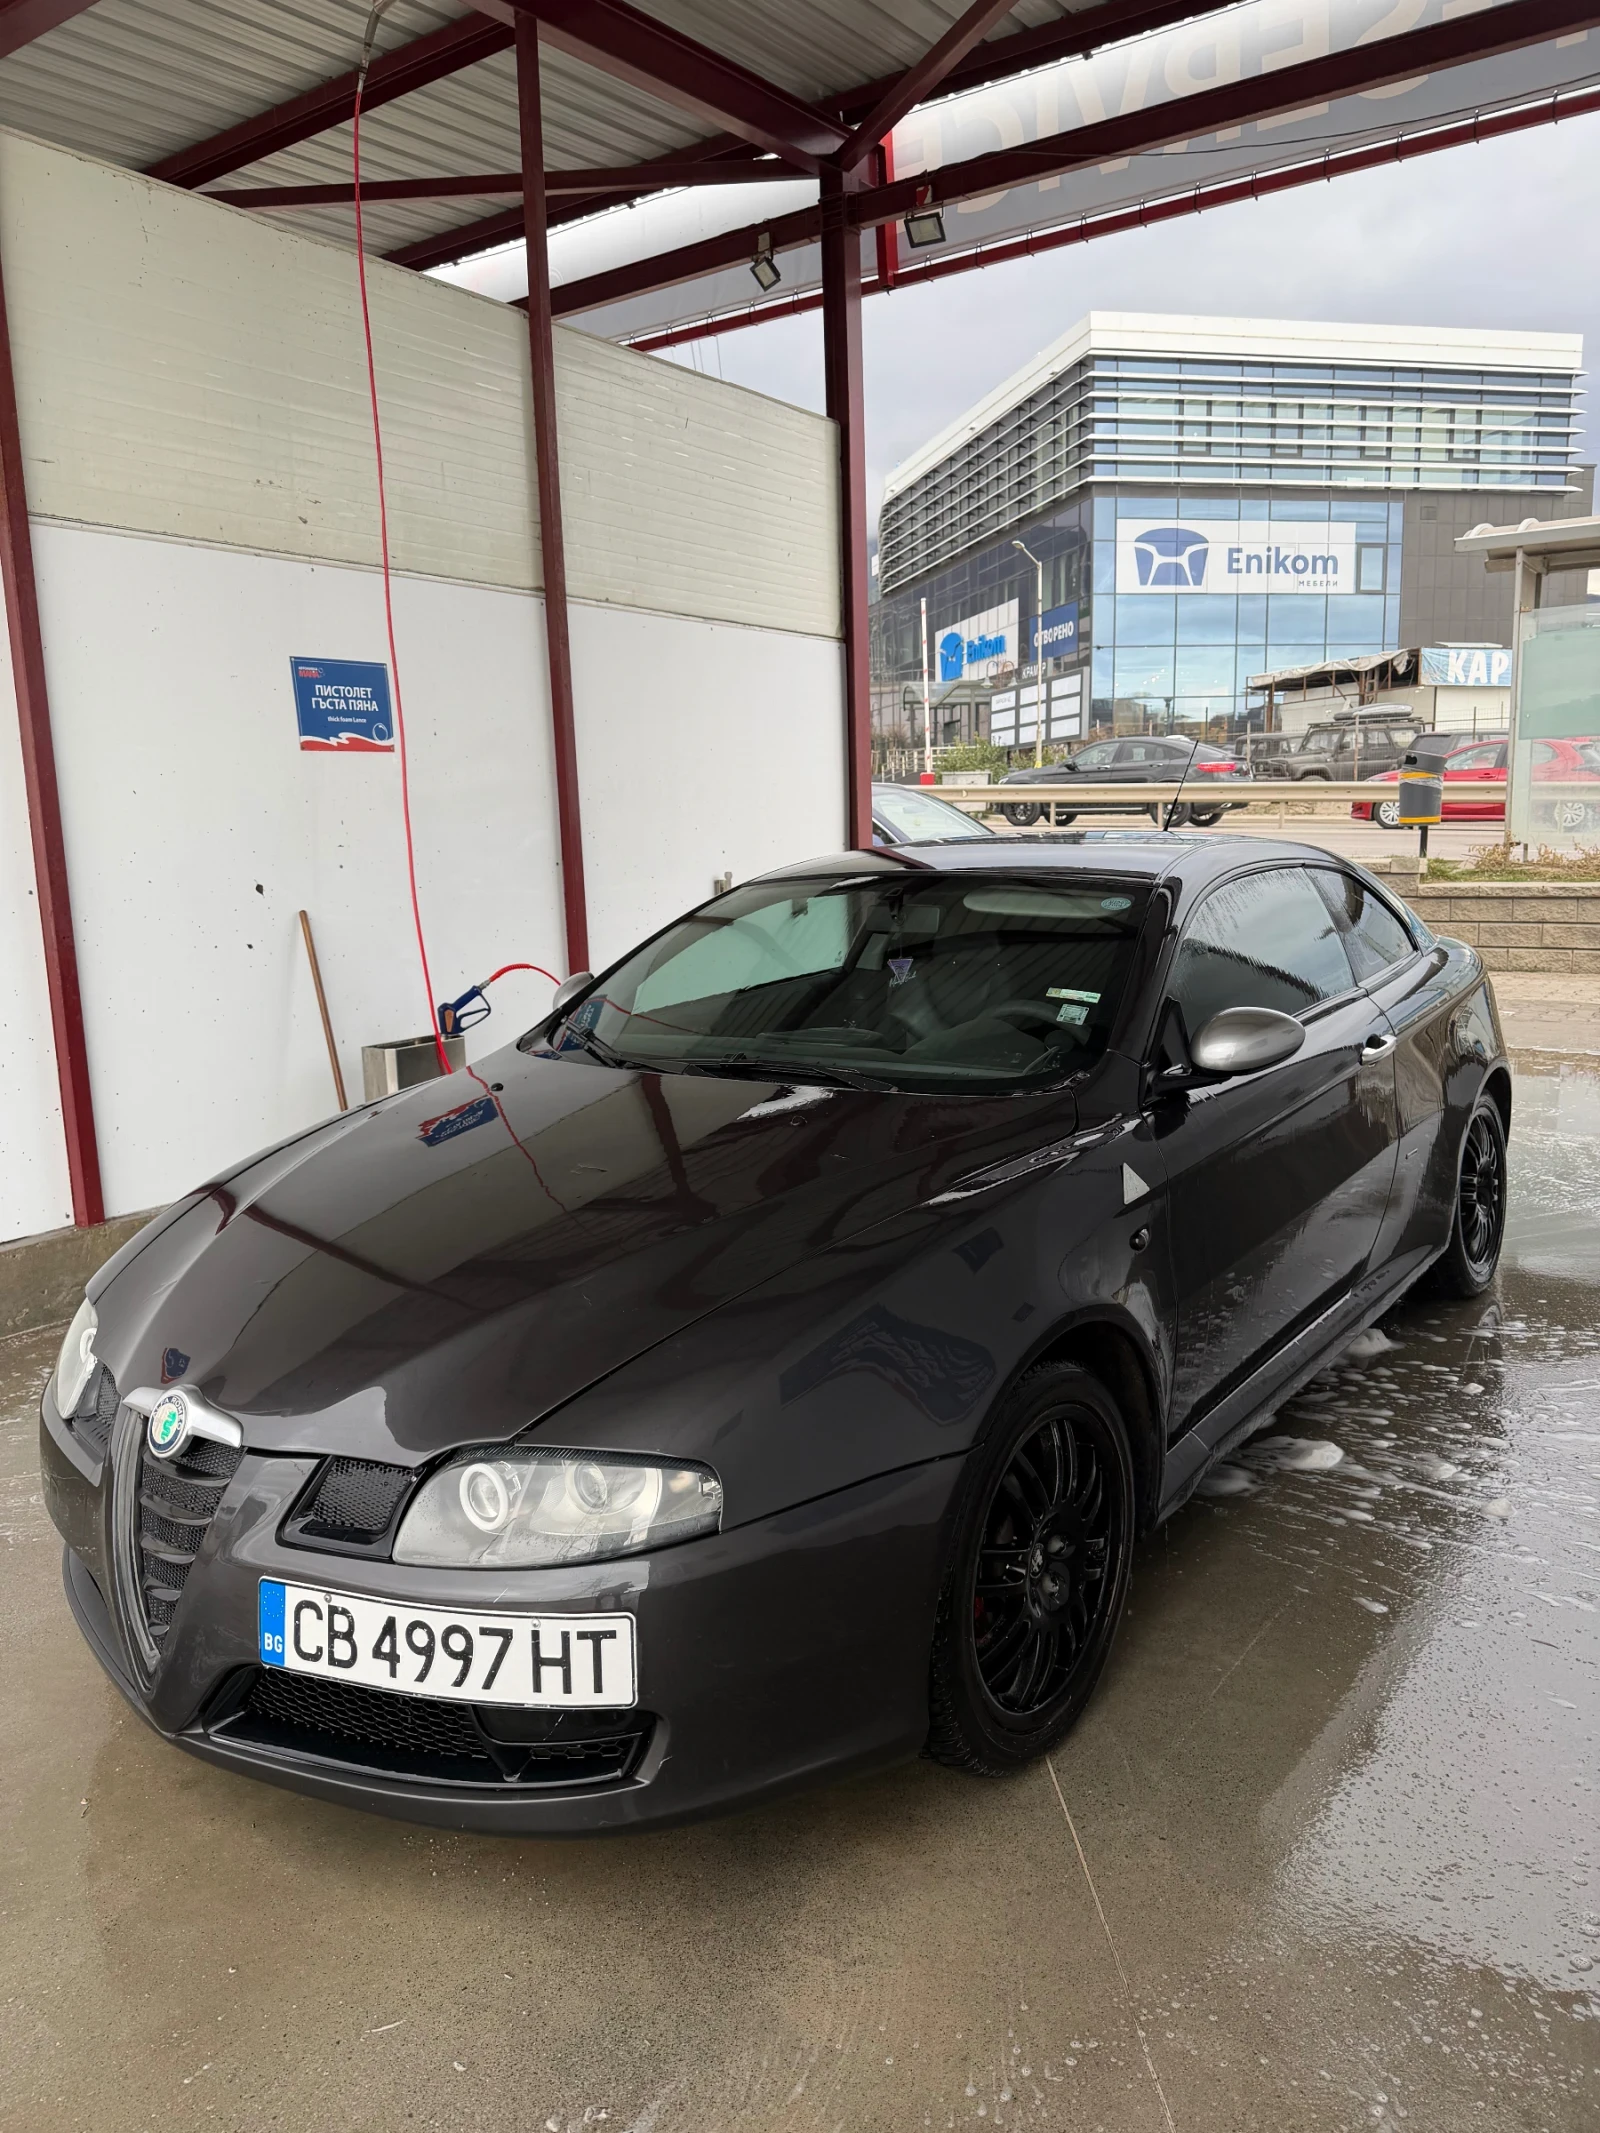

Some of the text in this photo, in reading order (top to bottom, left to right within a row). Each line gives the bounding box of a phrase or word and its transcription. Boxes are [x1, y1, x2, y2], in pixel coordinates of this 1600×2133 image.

[1227, 546, 1338, 575] Enikom
[966, 634, 1006, 664] Enikom
[1021, 662, 1046, 680] КРАМР
[315, 684, 372, 699] ПИСТОЛЕТ
[311, 697, 379, 712] ГЪСТА ПЯНА
[264, 1632, 283, 1654] BG
[293, 1599, 617, 1695] CB 4997 HT
